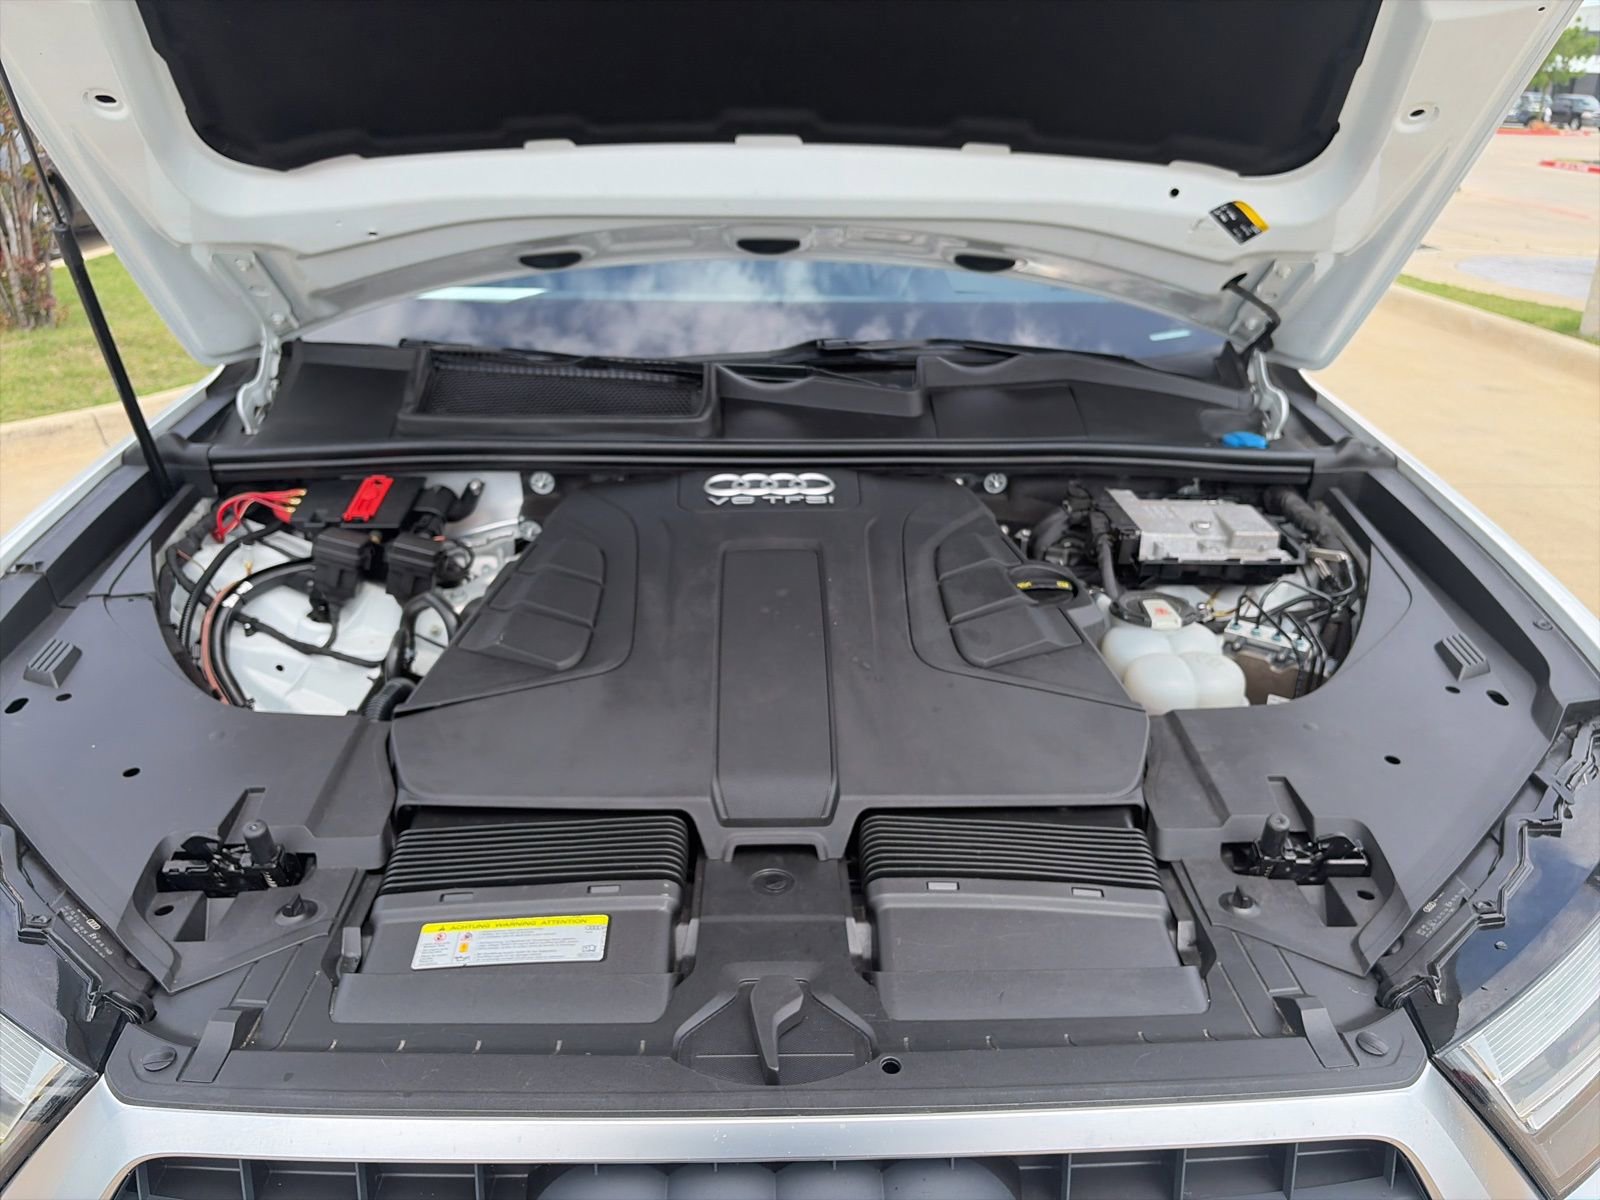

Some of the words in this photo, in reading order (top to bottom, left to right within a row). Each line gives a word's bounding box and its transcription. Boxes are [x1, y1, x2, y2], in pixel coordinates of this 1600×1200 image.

[450, 923, 490, 931] ACHTUNG
[495, 920, 537, 928] WARNING
[541, 918, 587, 926] ATTENTION
